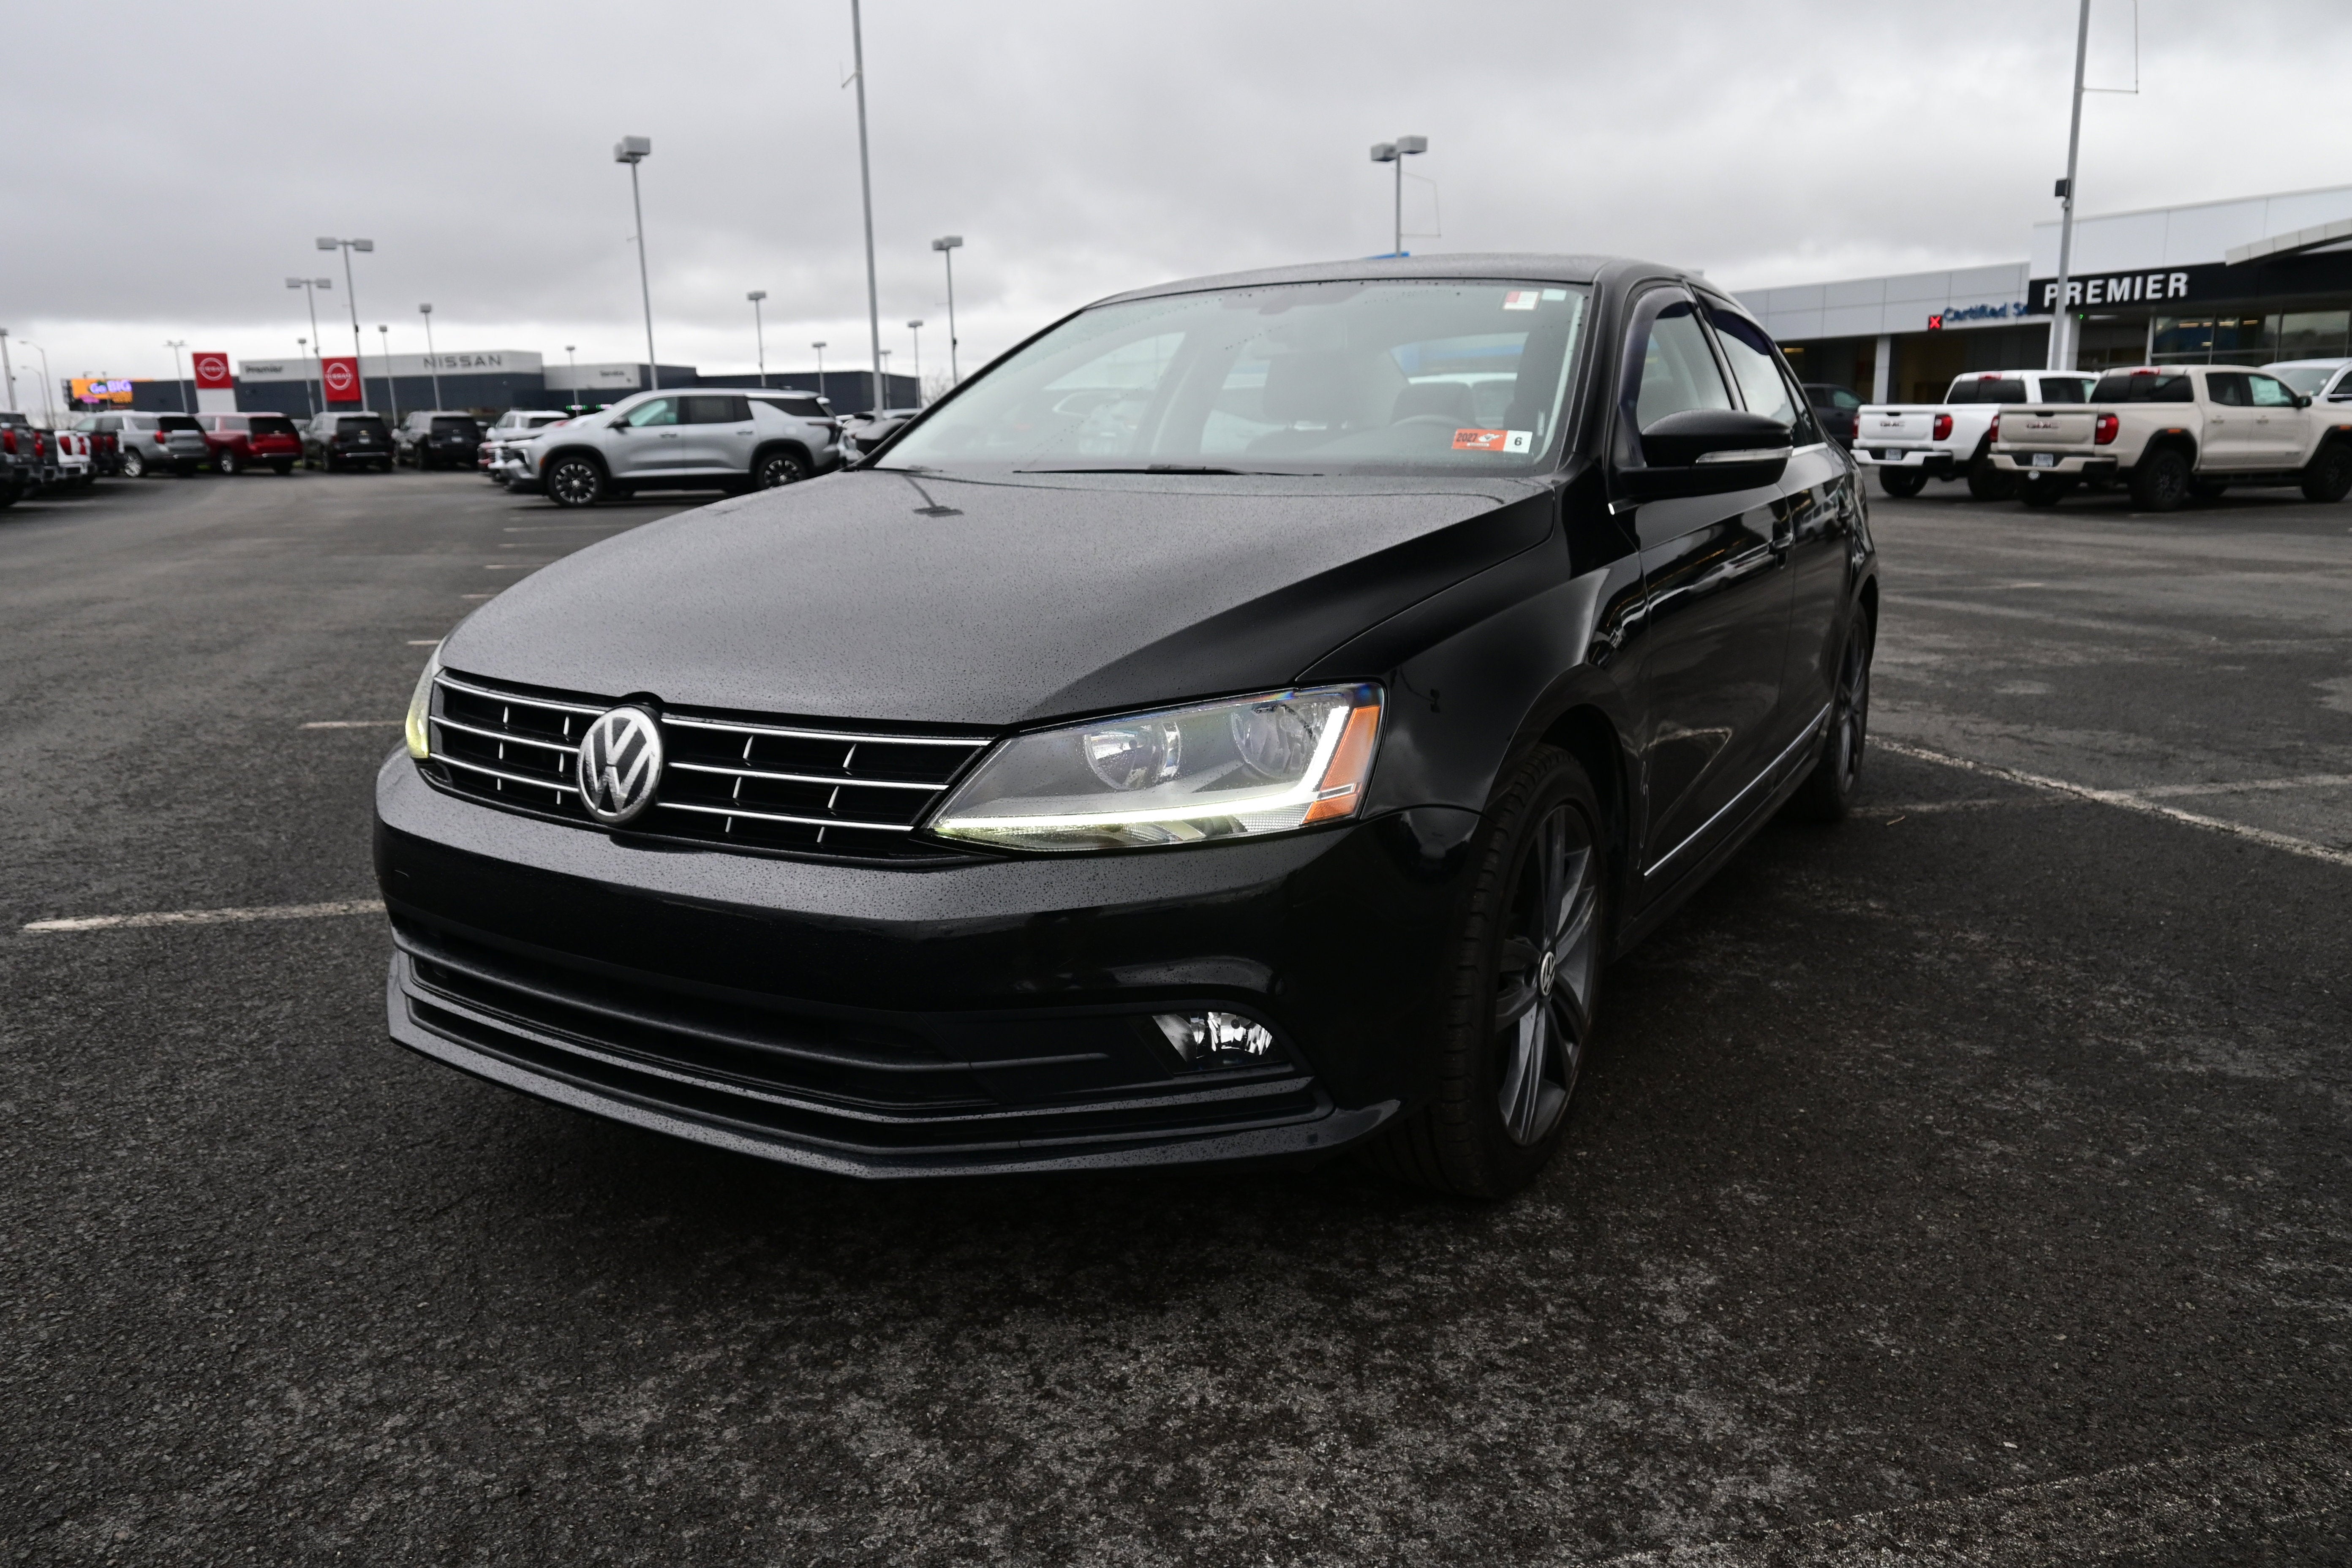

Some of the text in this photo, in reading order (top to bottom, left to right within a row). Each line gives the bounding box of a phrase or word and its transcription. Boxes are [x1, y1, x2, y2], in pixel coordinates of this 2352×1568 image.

[2044, 272, 2188, 308] PREMIER
[1944, 303, 2007, 321] Certified
[424, 355, 501, 368] NISSAN
[1456, 433, 1478, 442] 2027
[1514, 437, 1522, 445] 6
